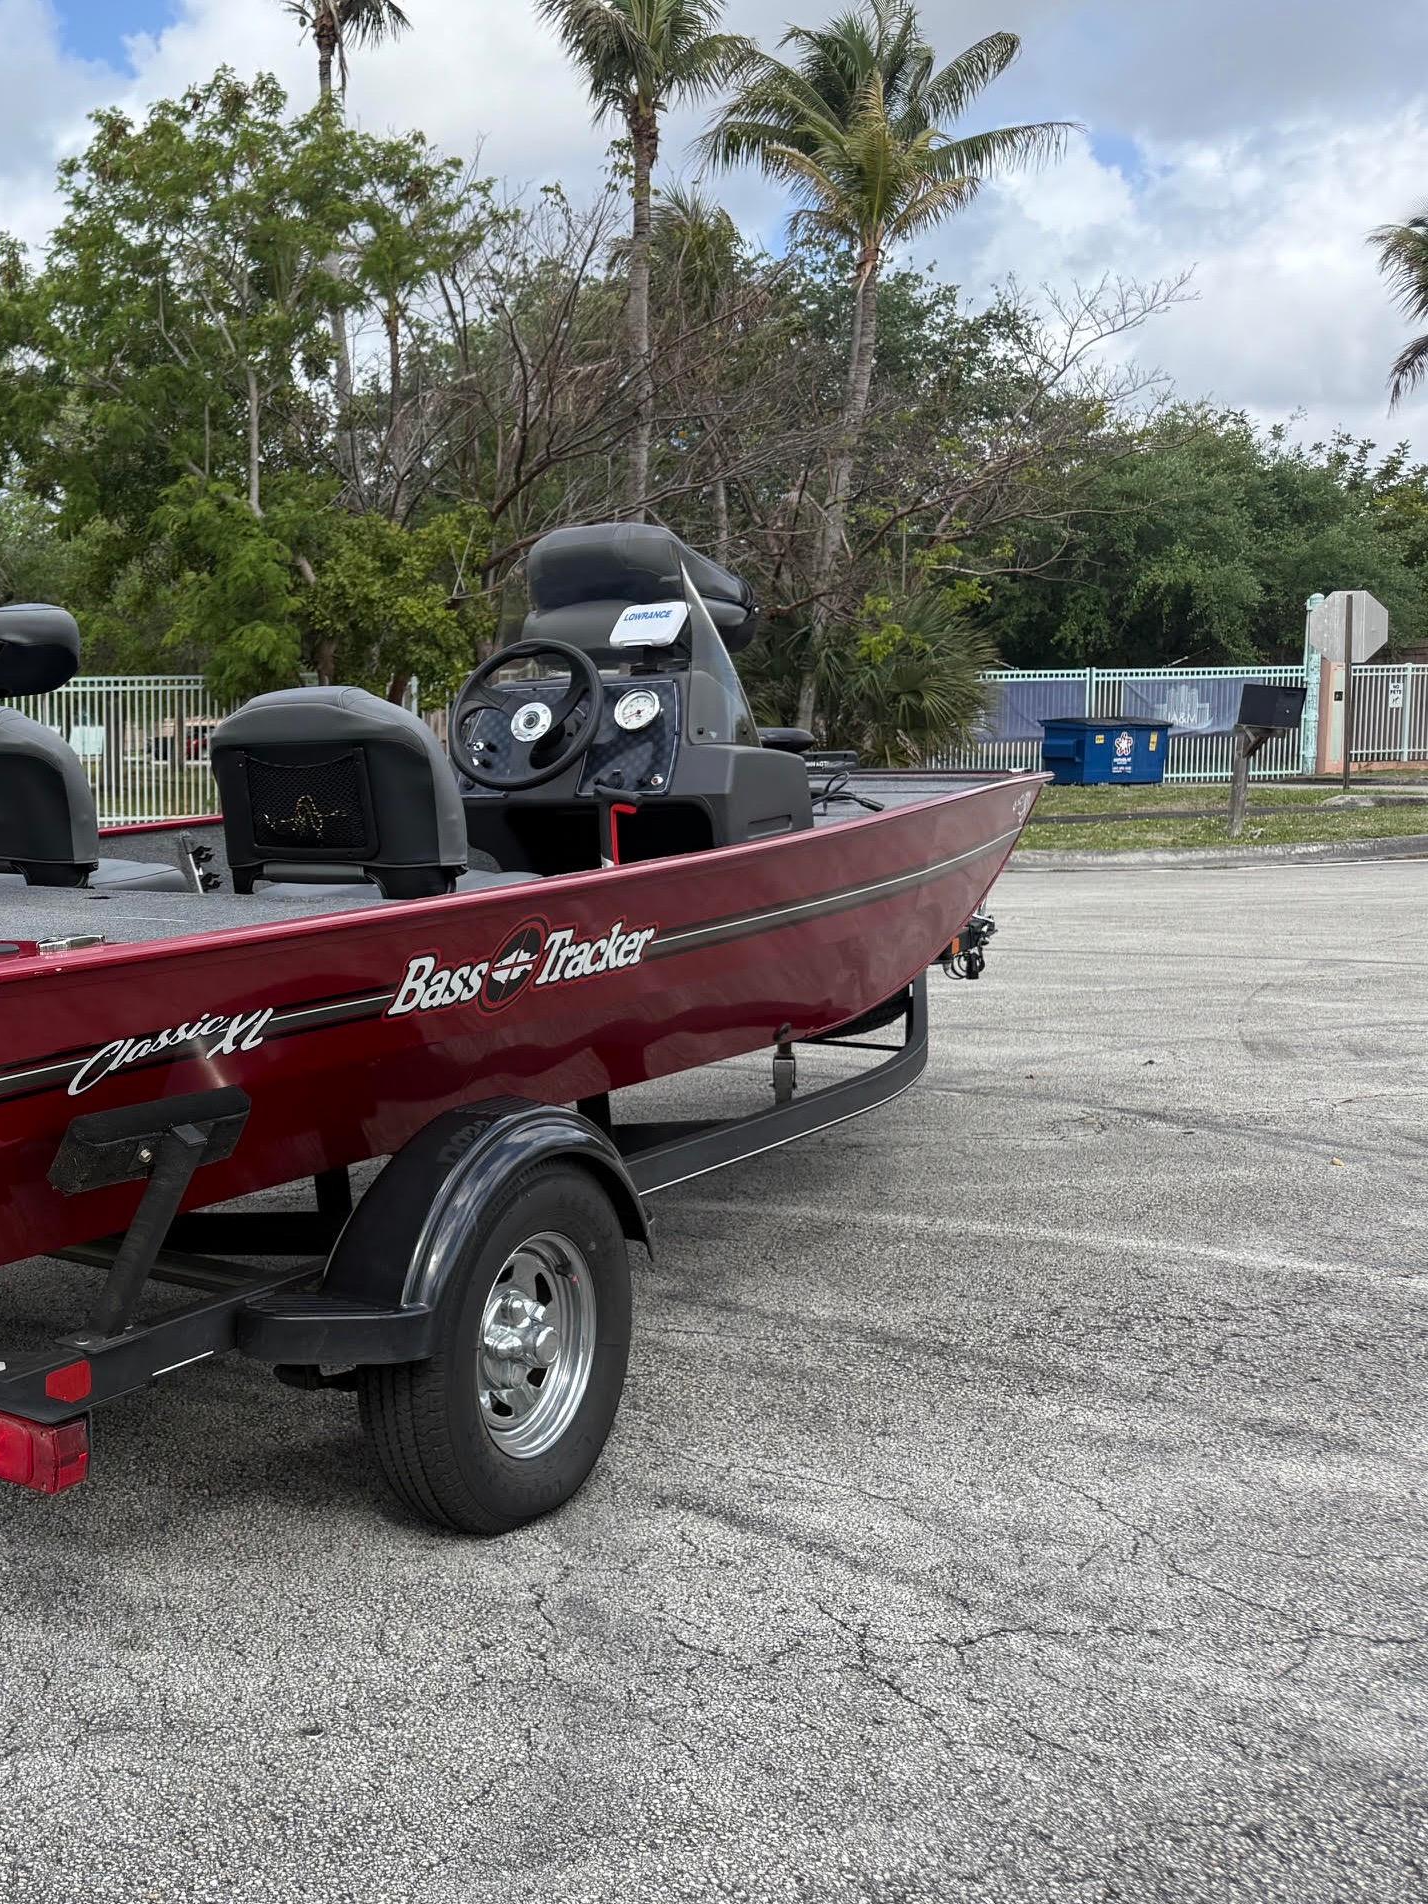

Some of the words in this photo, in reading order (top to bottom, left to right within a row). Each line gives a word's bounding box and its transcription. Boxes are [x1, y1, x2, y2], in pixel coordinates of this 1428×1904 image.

[624, 610, 673, 621] LOWRANCE
[387, 956, 489, 1016] Bass
[535, 922, 655, 985] Tracker
[67, 1013, 229, 1096] Classic
[205, 1007, 274, 1060] XL
